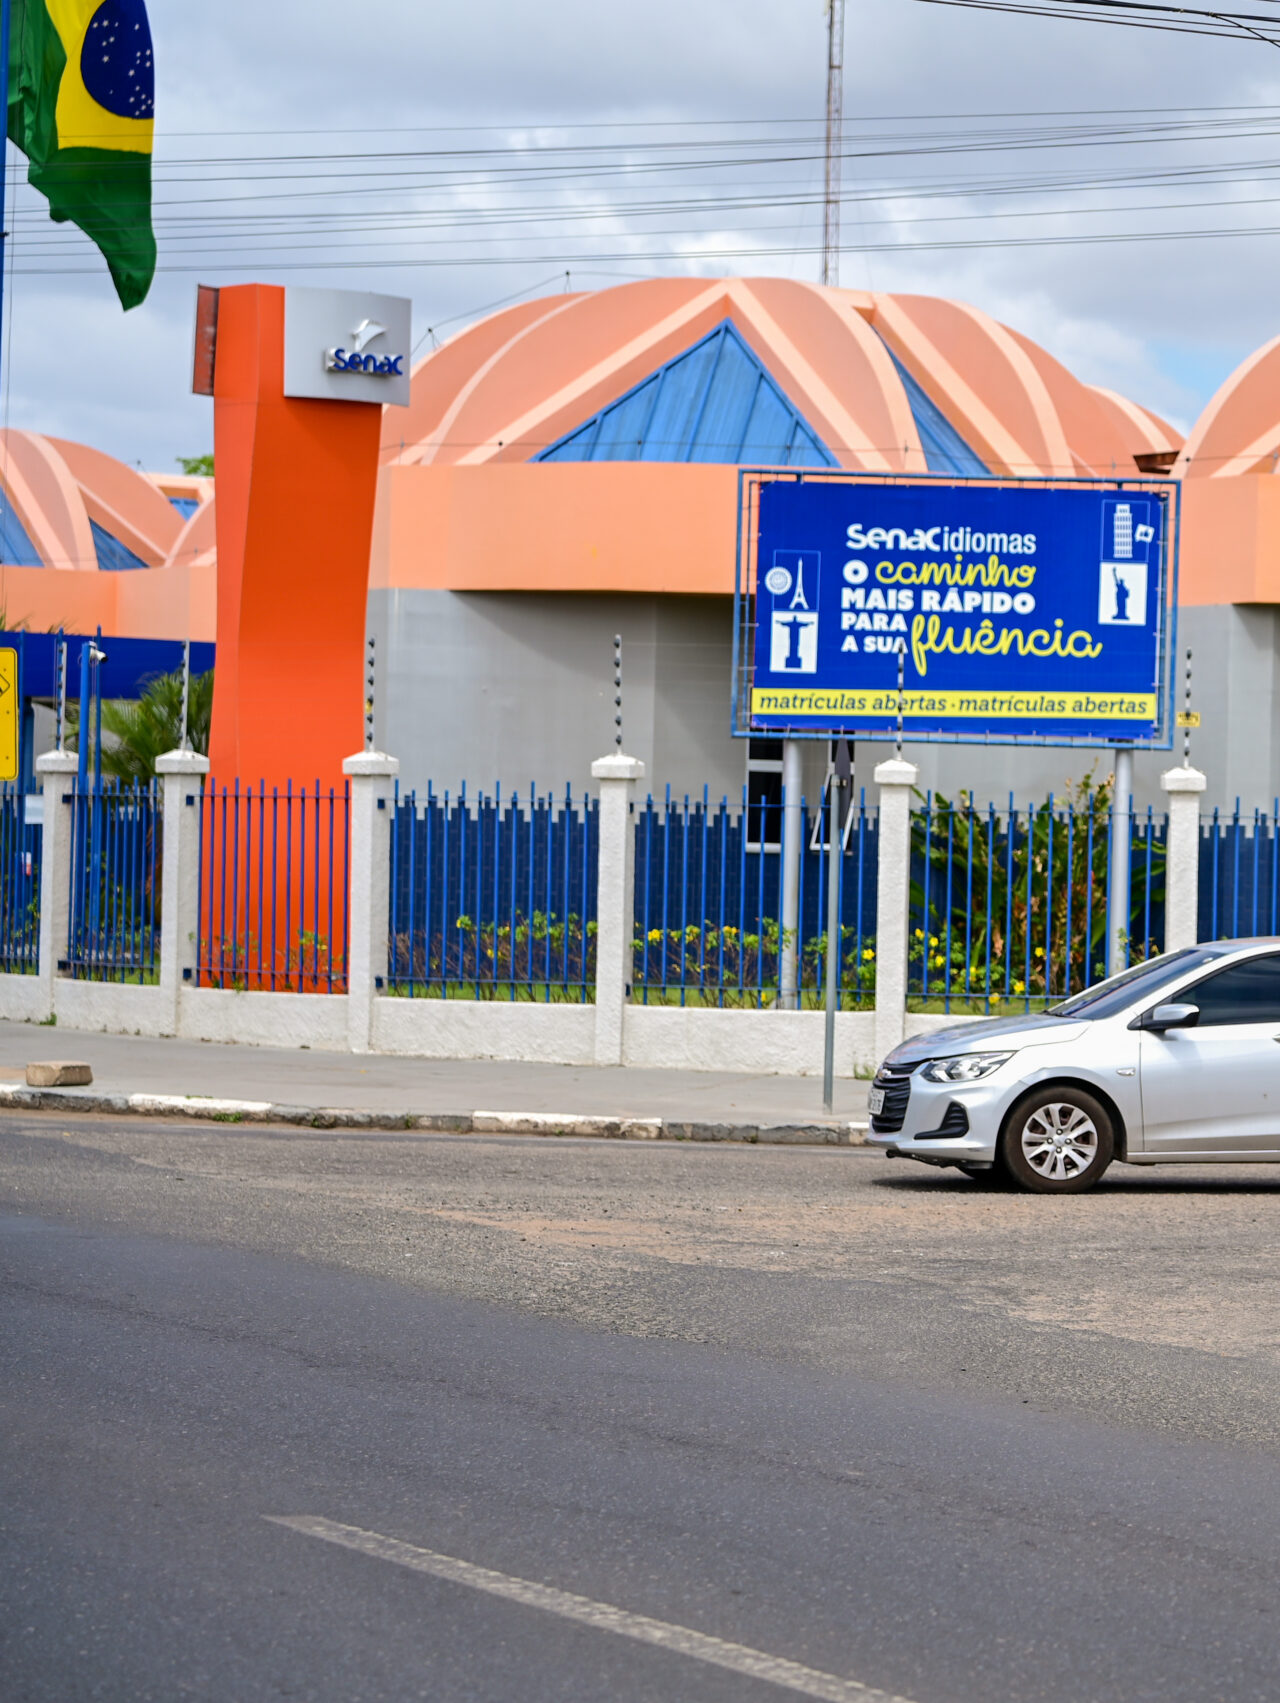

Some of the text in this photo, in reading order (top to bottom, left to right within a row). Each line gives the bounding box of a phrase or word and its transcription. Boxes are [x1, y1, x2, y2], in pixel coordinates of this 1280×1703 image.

[333, 348, 403, 376] Senac
[846, 523, 1037, 555] Senac idiomas
[842, 554, 1037, 588] O caminho
[841, 587, 1036, 615] MAIS RÁPIDO
[841, 612, 908, 632] PARA
[841, 635, 908, 654] A SUA
[911, 614, 1103, 677] fluência
[759, 692, 867, 710] matrículas
[958, 696, 1067, 713] matrículas
[1072, 697, 1148, 714] abertas
